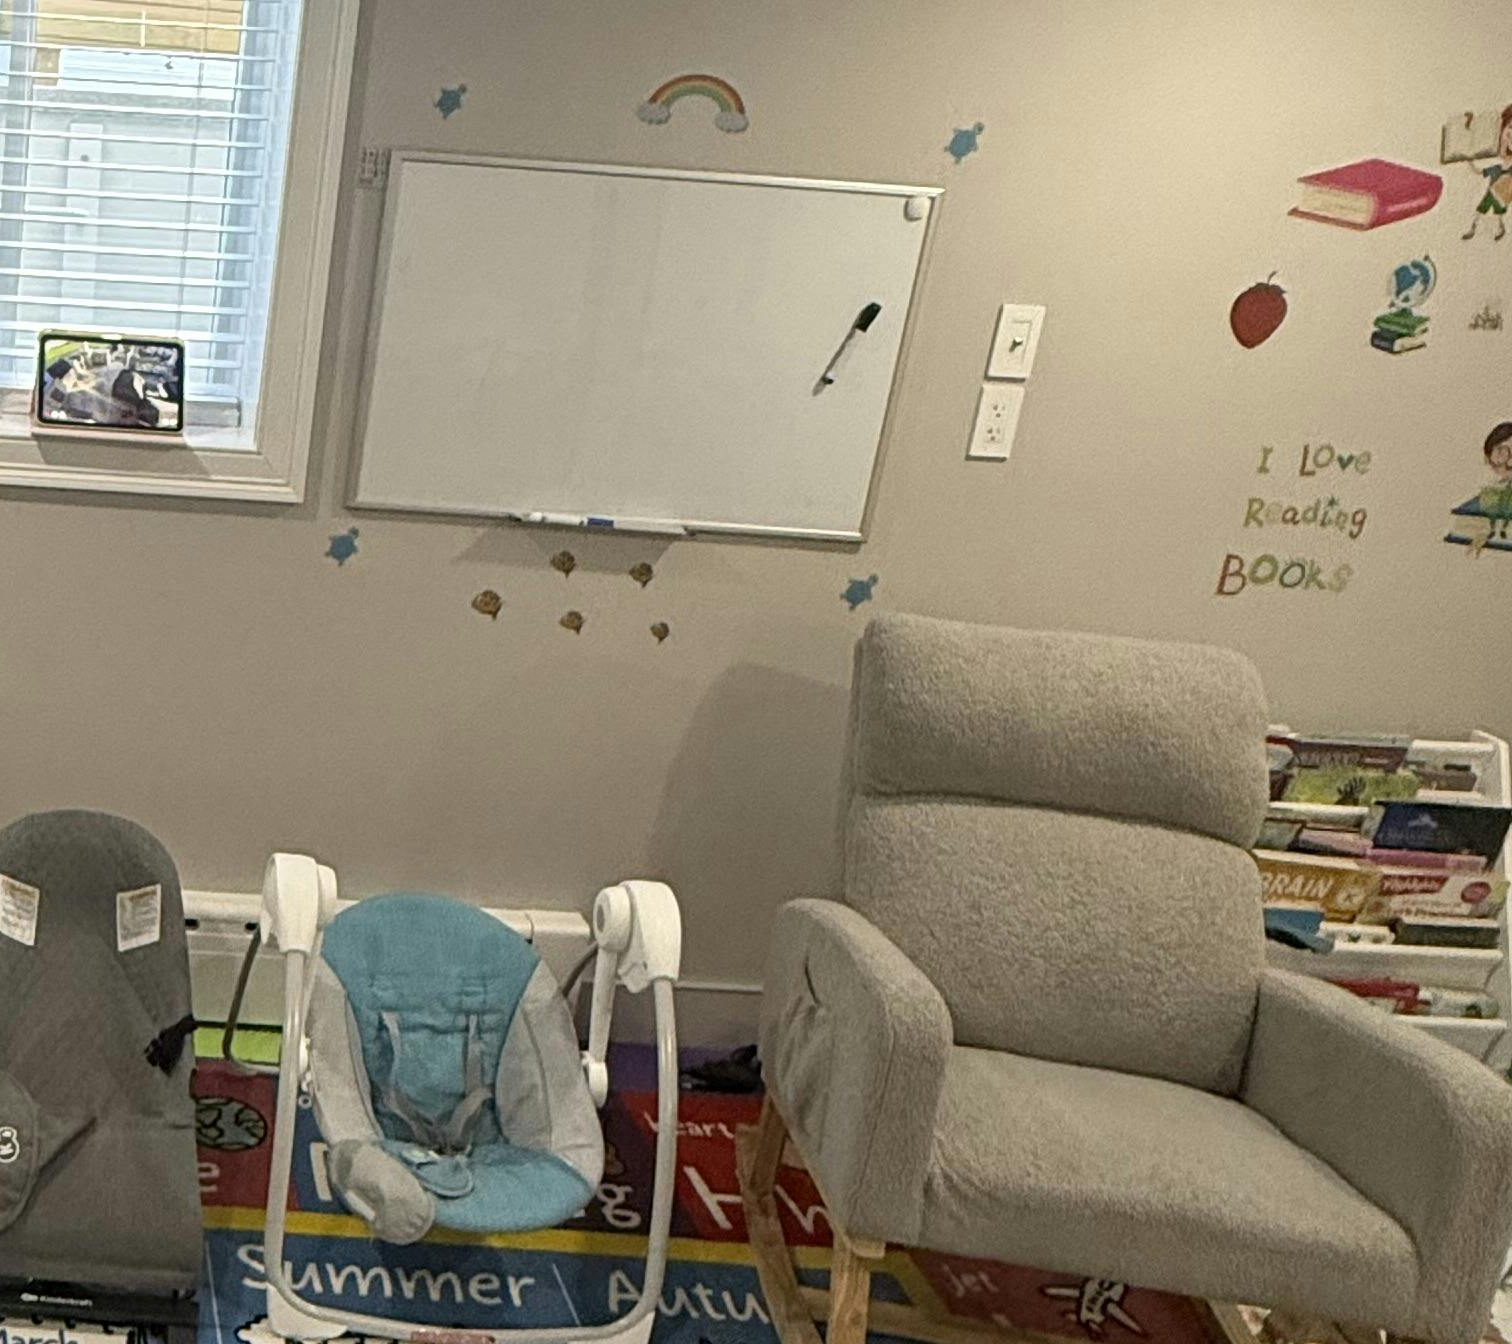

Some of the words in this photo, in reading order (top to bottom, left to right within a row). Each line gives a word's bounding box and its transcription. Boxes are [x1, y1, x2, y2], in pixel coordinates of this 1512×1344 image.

[1257, 445, 1274, 474] I
[1243, 495, 1367, 539] Reading
[236, 1244, 535, 1307] Summer
[608, 1269, 770, 1325] Autu
